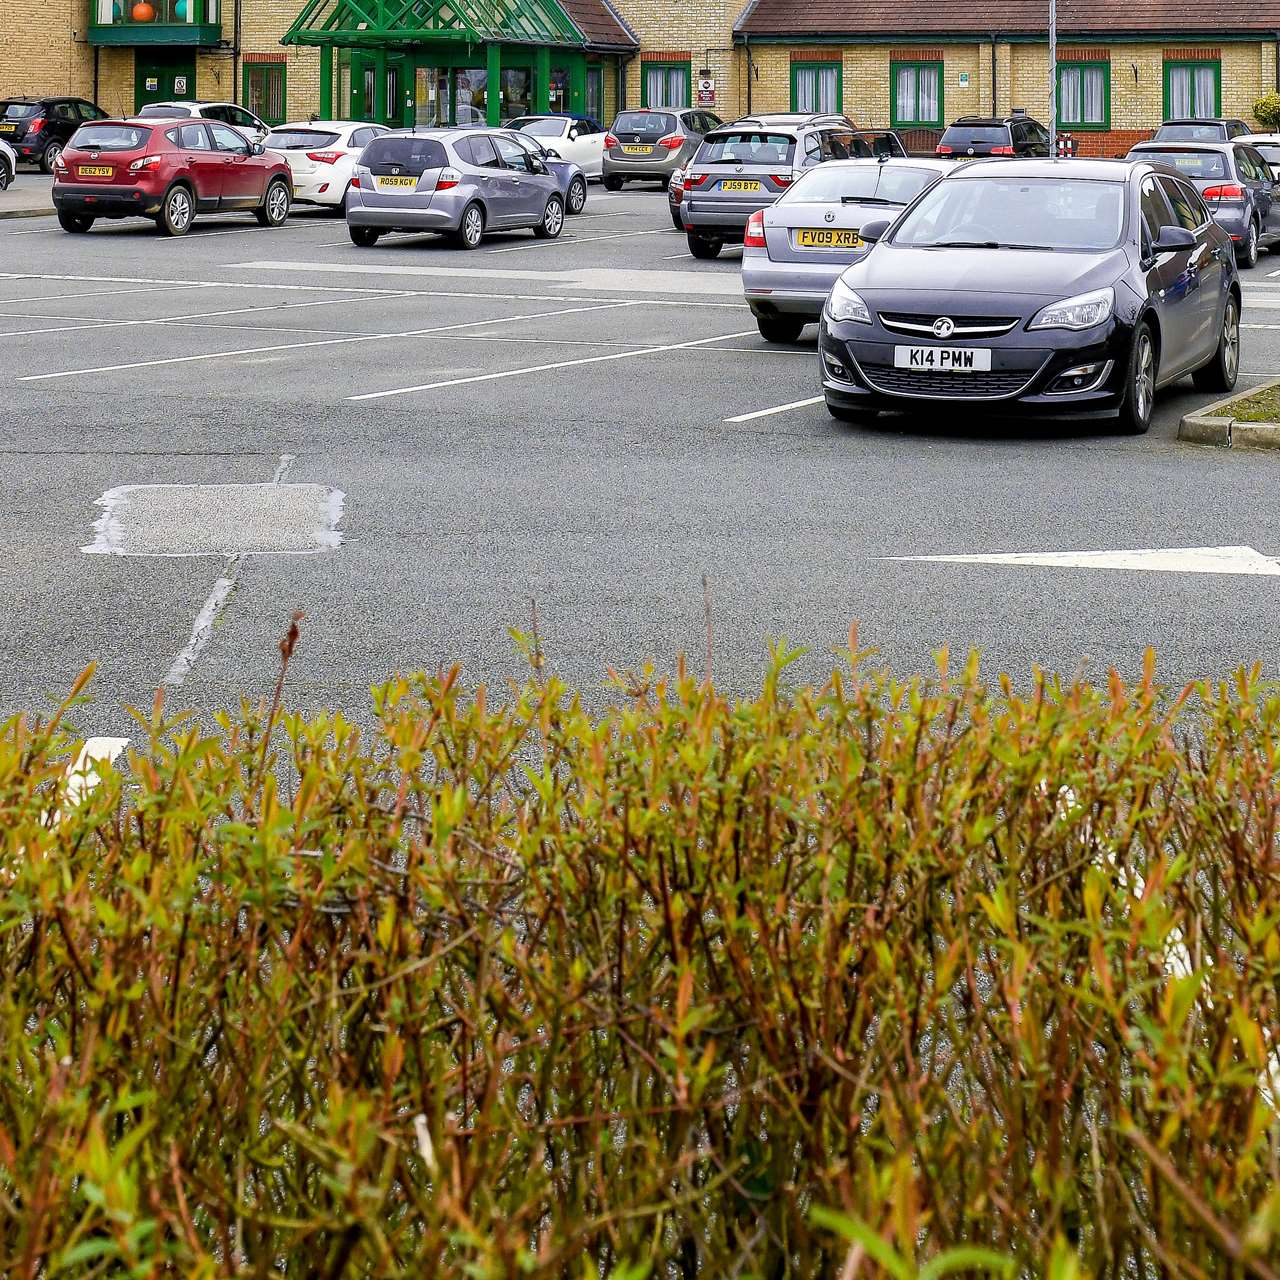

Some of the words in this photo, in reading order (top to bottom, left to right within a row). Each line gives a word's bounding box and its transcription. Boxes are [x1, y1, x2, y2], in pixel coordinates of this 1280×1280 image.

[722, 181, 741, 190] PJ59
[743, 182, 759, 190] BTZ
[802, 231, 833, 243] FV09
[835, 232, 859, 244] XRB
[910, 349, 935, 366] K14
[940, 350, 974, 367] PMW
